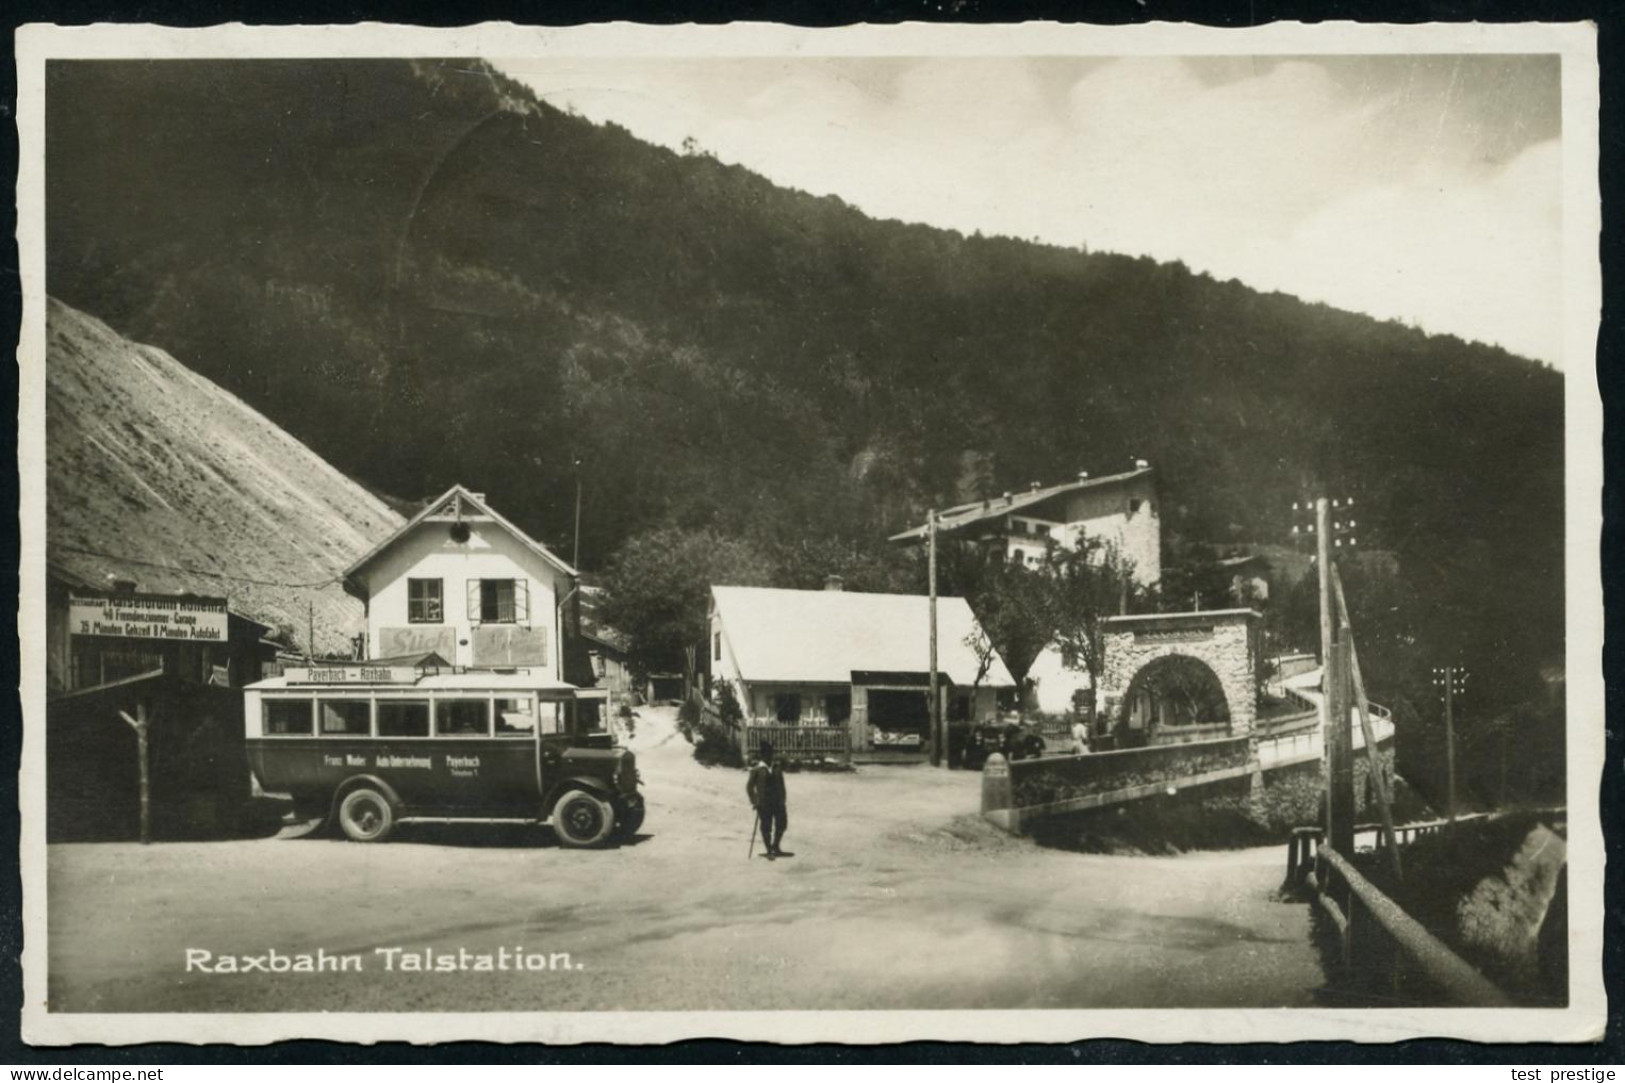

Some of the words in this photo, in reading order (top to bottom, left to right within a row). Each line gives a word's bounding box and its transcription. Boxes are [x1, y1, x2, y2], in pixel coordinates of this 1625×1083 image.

[174, 611, 197, 626] Garage
[93, 621, 122, 635] Minuten
[159, 624, 188, 638] Minuten
[190, 626, 221, 640] Autofahrt
[360, 667, 392, 680] Raxbahn
[324, 754, 343, 767] Franz
